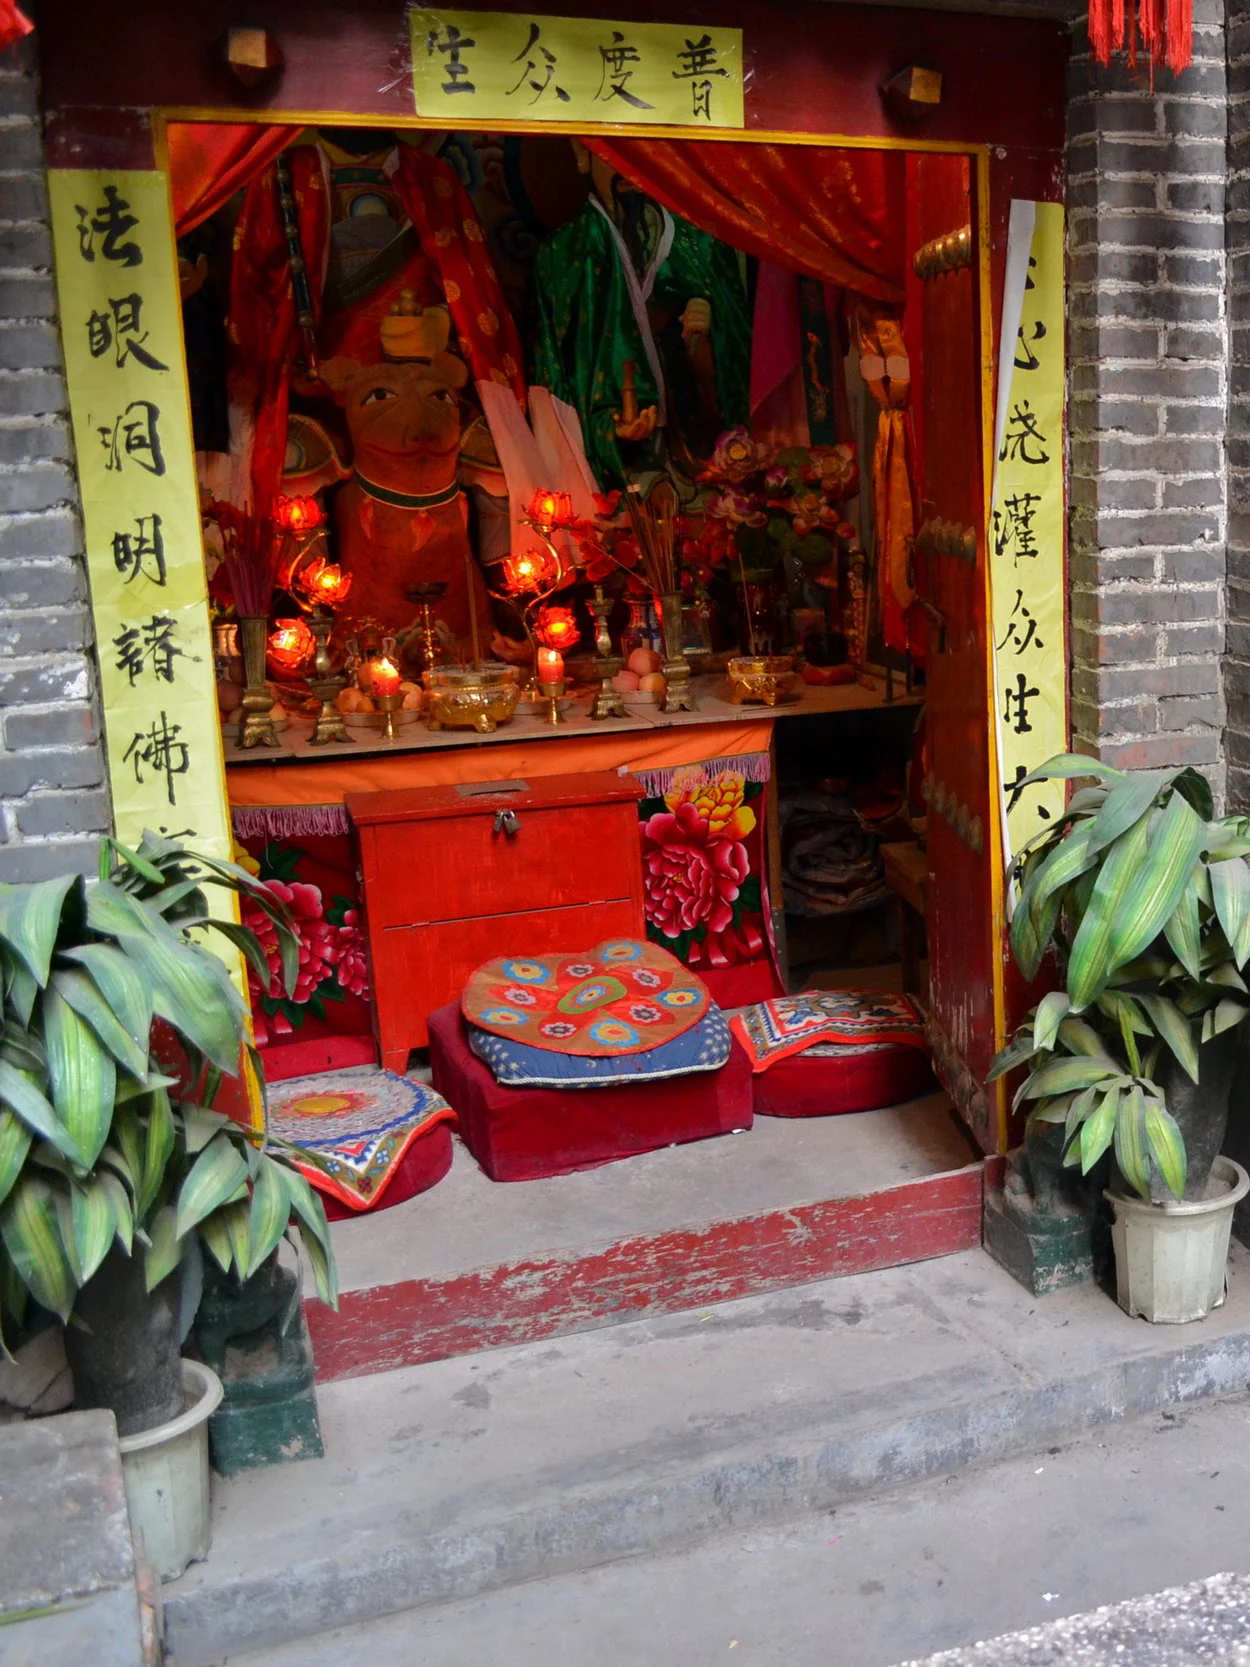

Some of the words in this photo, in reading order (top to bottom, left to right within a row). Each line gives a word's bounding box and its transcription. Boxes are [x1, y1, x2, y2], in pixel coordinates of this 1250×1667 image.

[74, 185, 232, 977] 法眼洞明諸佛
